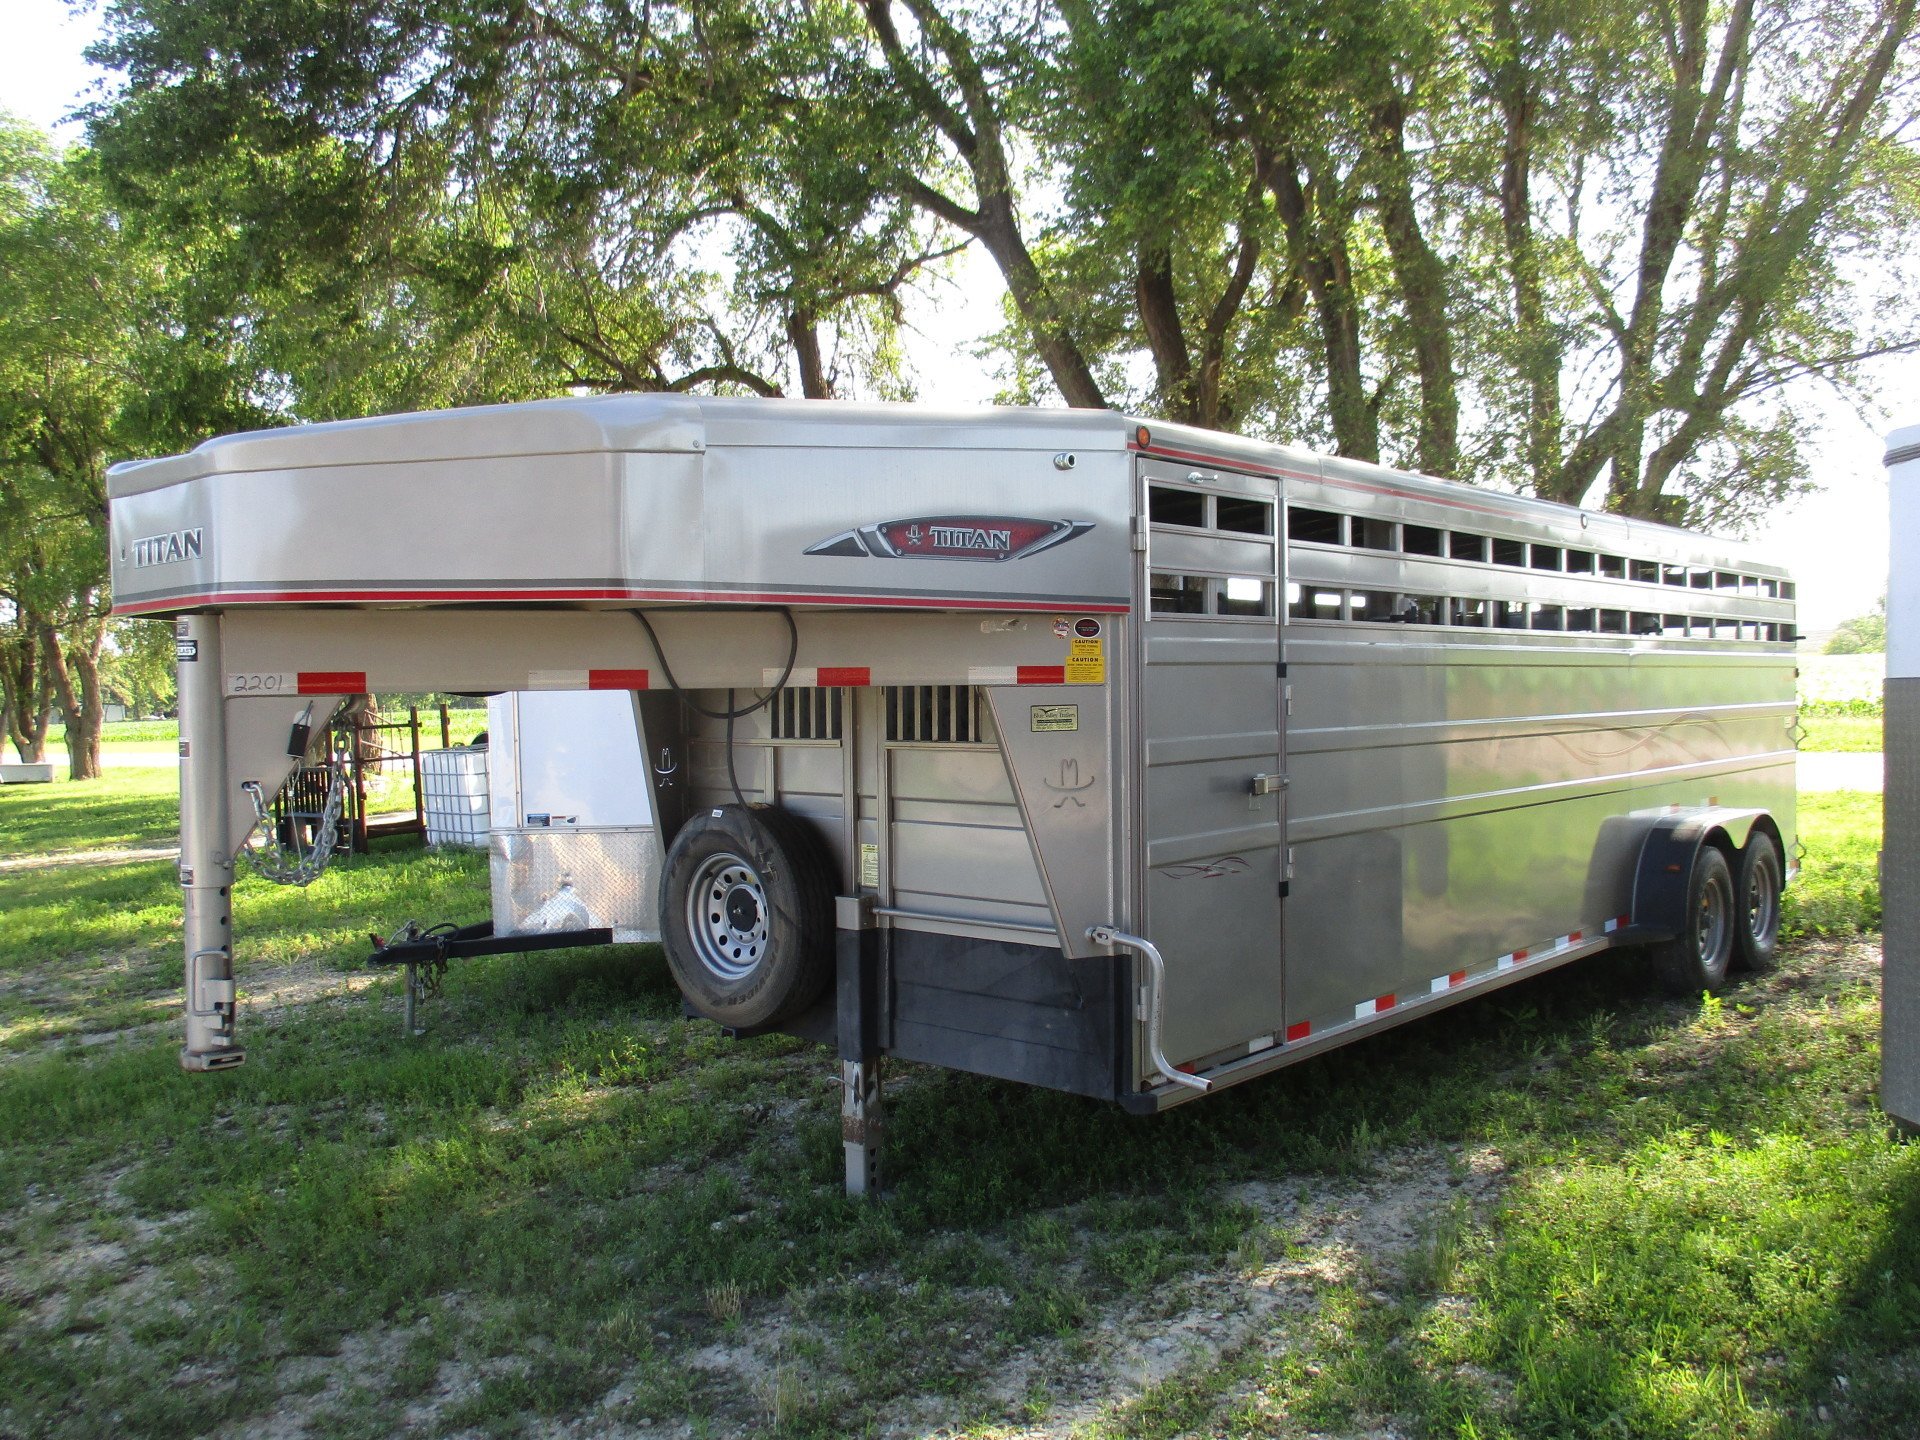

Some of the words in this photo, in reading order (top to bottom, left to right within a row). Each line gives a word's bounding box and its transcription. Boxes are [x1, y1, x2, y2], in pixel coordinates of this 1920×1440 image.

[132, 527, 203, 569] TITAN
[929, 526, 1010, 550] TITAN
[234, 675, 283, 692] 2201
